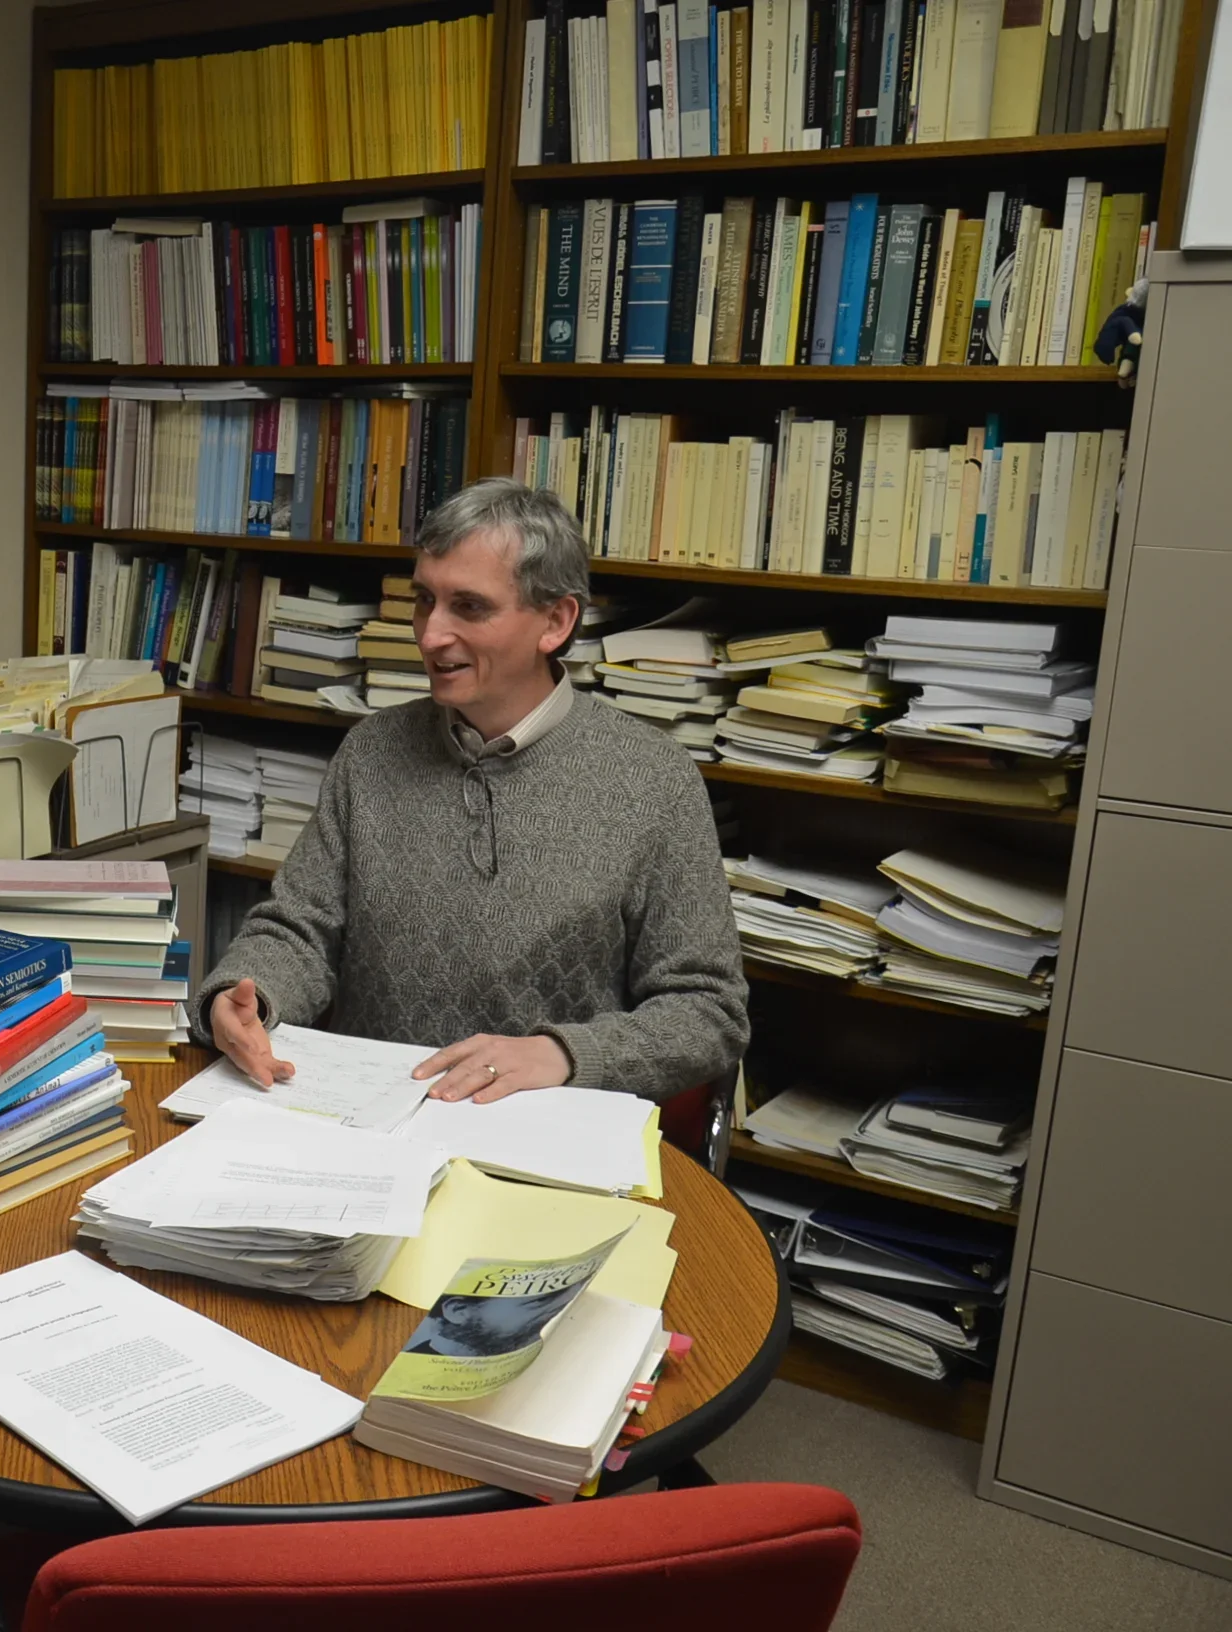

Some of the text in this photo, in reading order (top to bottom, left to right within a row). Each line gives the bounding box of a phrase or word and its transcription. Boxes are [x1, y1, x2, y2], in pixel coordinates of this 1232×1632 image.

[665, 38, 675, 120] POPPER SELECTIONS
[733, 29, 743, 108] THE WILL TO BELIEVE
[808, 47, 818, 98] NICOMACHEAN
[883, 33, 895, 94] Nicomachean Ethics
[846, 67, 855, 104] EXECUTION
[807, 99, 815, 124] ETHICS
[843, 115, 851, 146] SOCRATES
[1086, 195, 1097, 220] KANT
[782, 218, 793, 261] JAMES
[871, 215, 886, 280] FOUR PRAGMATISTS
[891, 235, 916, 245] Dewey
[895, 228, 914, 237] John
[556, 224, 573, 297] THE MIND
[586, 206, 607, 323] VUES DE L'ESPRIT
[758, 214, 771, 299] AMERICAN PHILOSOPHY
[922, 244, 931, 262] Guide
[941, 250, 950, 271] Modes
[716, 222, 736, 342] PHILOSOPHY IN AMERICA
[731, 260, 740, 298] HISTORY
[917, 280, 926, 297] Works
[919, 269, 927, 279] the
[728, 300, 736, 316] OF
[937, 280, 947, 307] Thought
[948, 244, 971, 344] Science and Philosophy
[865, 304, 875, 330] Scheffler
[913, 306, 922, 320] John
[610, 315, 621, 346] BACH
[910, 320, 920, 339] Dewey
[581, 427, 589, 454] Berkeley
[420, 453, 428, 481] ANCIENT
[616, 460, 624, 471] and
[826, 427, 848, 537] BEING AND TIME
[418, 482, 427, 519] PHILOSOPHY
[840, 481, 853, 547] MARTIN HEIDEGGER
[4, 958, 48, 992] SEMIOTICS
[15, 982, 29, 995] Kruse
[35, 1078, 61, 1096] Animal
